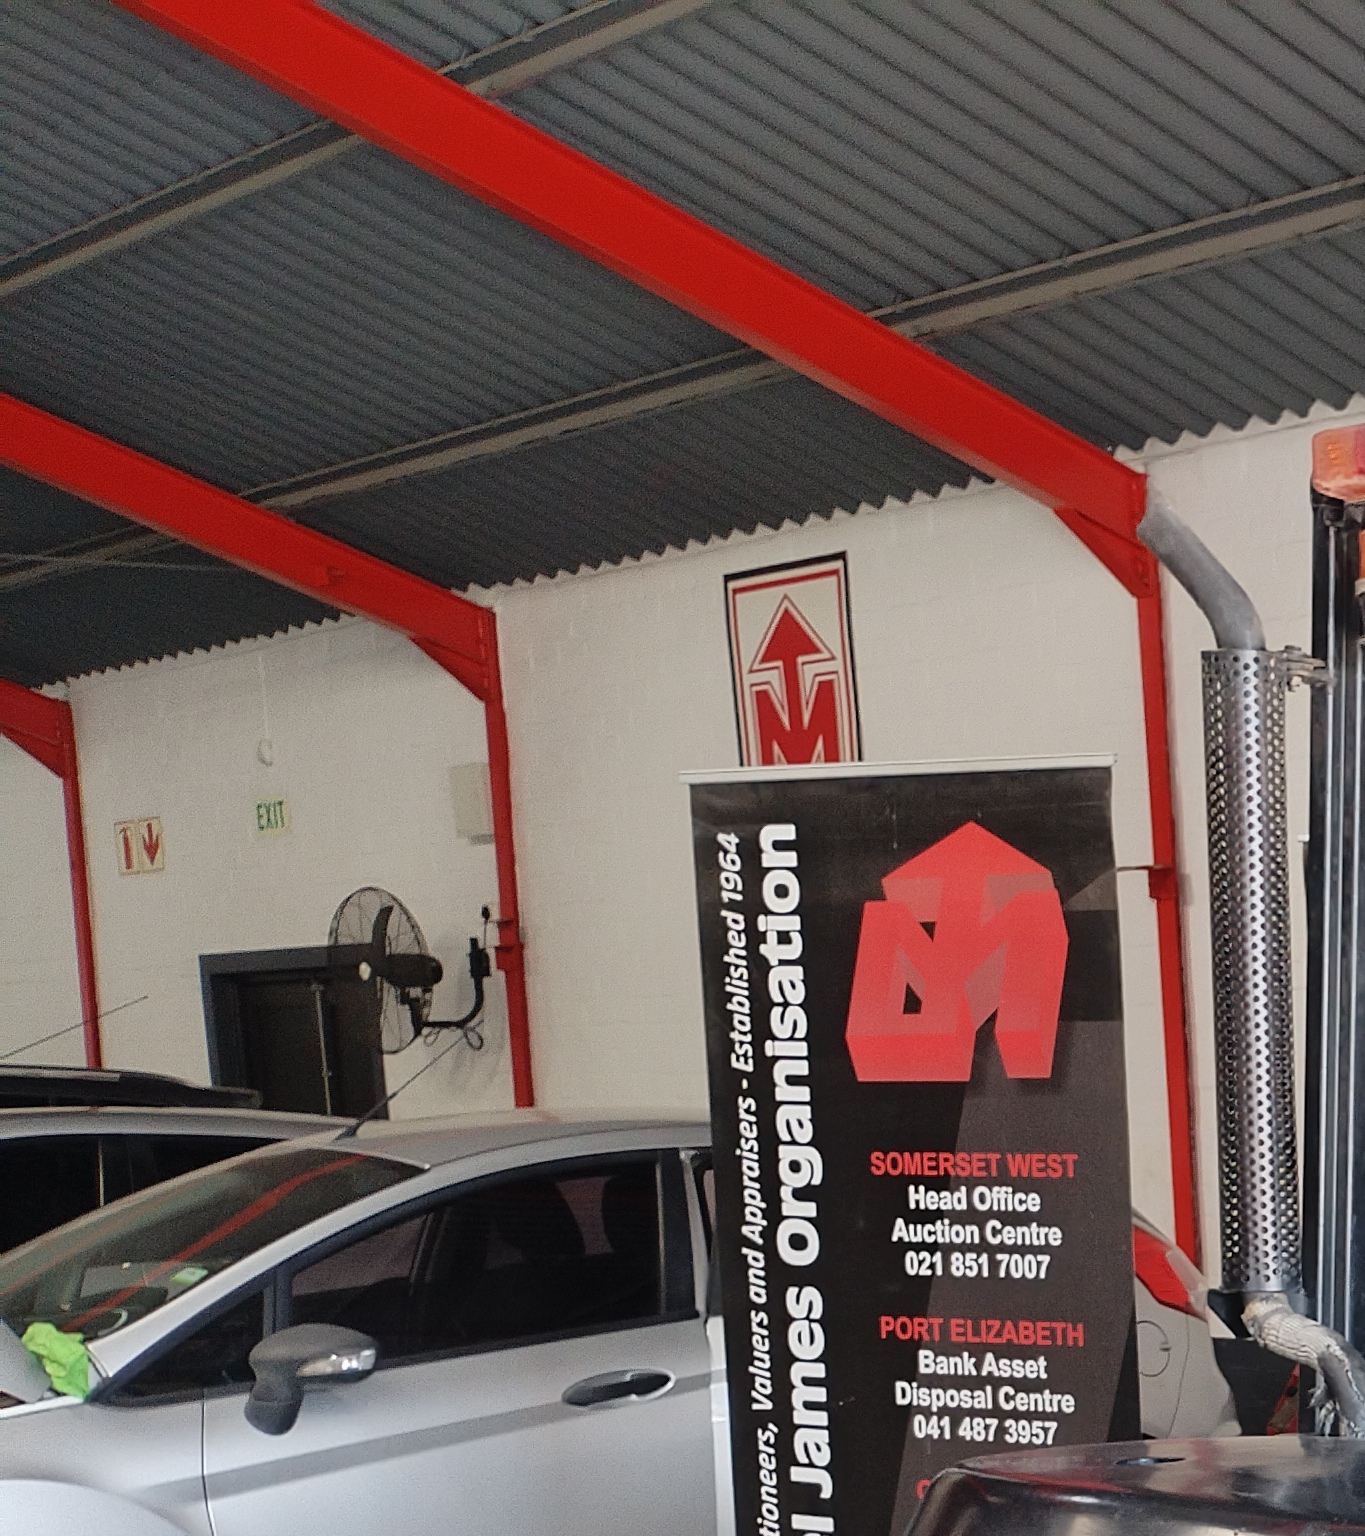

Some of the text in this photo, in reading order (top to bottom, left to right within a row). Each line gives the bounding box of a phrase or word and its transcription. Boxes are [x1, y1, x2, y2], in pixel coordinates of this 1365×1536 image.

[256, 800, 285, 831] EXIT
[716, 832, 744, 903] 1964
[719, 909, 754, 1073] Established
[757, 823, 823, 1267] Organisation
[735, 1095, 768, 1246] Appraisers
[869, 1150, 1079, 1179] SOMERSET WEST
[908, 1184, 1041, 1212] Head Office
[891, 1217, 1063, 1247] Auction Centre
[742, 1246, 768, 1305] and
[905, 1250, 1051, 1280] 021 851 7007
[879, 1315, 1085, 1347] PORT ELIZABETH
[748, 1310, 774, 1411] Valuers
[918, 1349, 1048, 1380] Bank Asset
[786, 1286, 833, 1499] James
[895, 1380, 1075, 1414] Disposal Centre
[913, 1414, 1058, 1445] 041 487 3957
